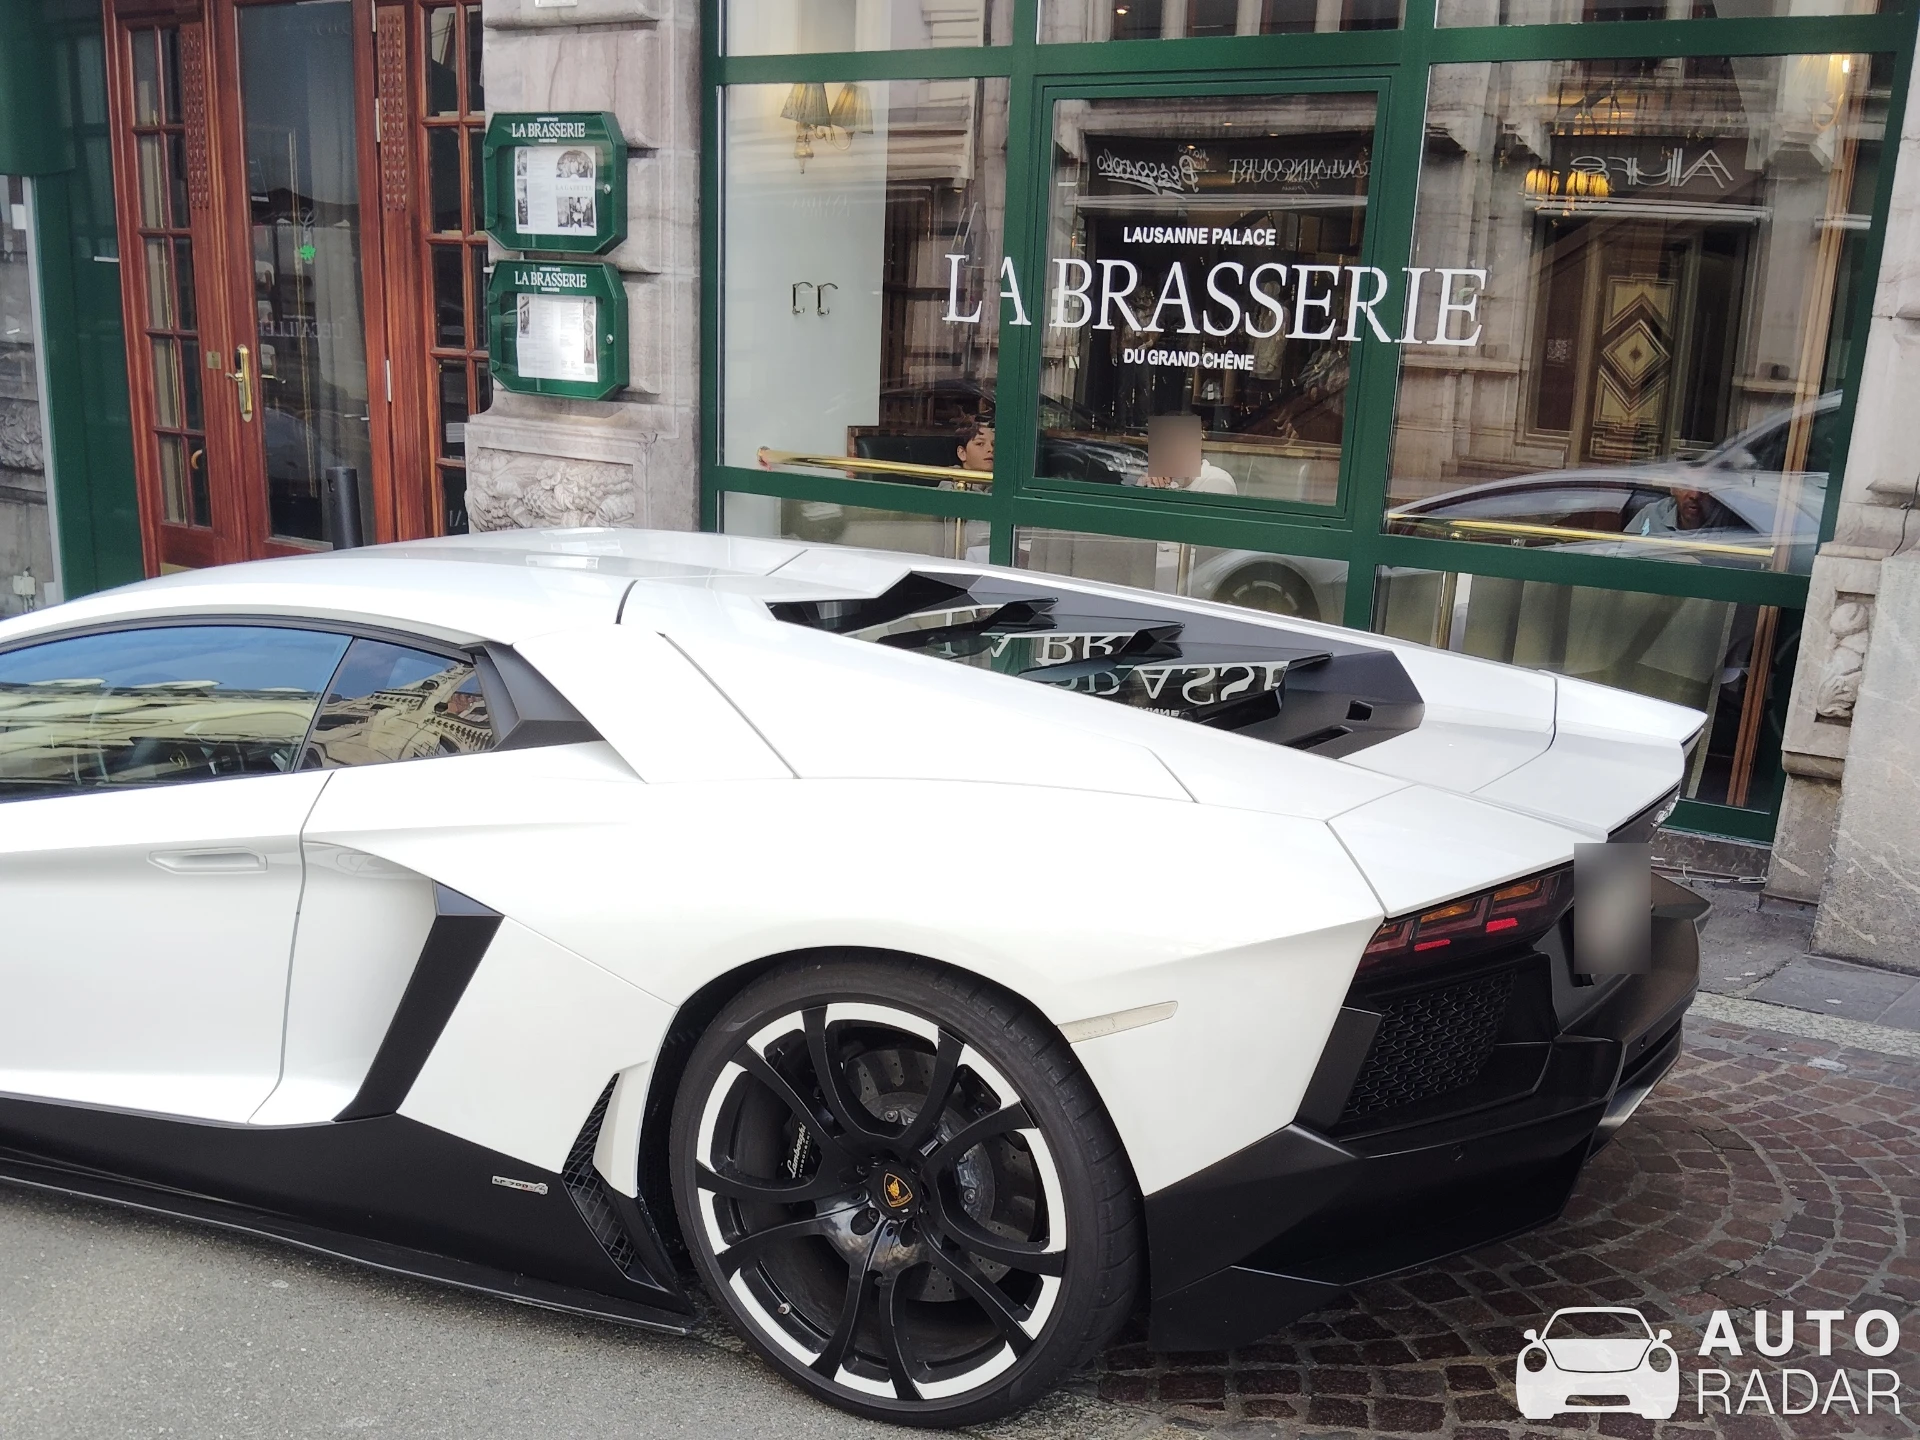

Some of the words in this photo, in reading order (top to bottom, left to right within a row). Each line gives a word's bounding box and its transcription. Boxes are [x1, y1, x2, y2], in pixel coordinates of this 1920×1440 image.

[511, 122, 527, 138] LA
[527, 122, 586, 138] BRASSERIE
[1123, 226, 1209, 245] LAUSANNE
[1211, 228, 1277, 246] PALACE
[514, 270, 530, 286] LA
[530, 271, 588, 289] BRASSERIE
[941, 253, 1033, 326] LA
[1048, 257, 1487, 348] BRASSERIE
[1123, 348, 1146, 365] DU
[1147, 350, 1200, 368] GRAND
[1202, 350, 1255, 371] CHÊNE
